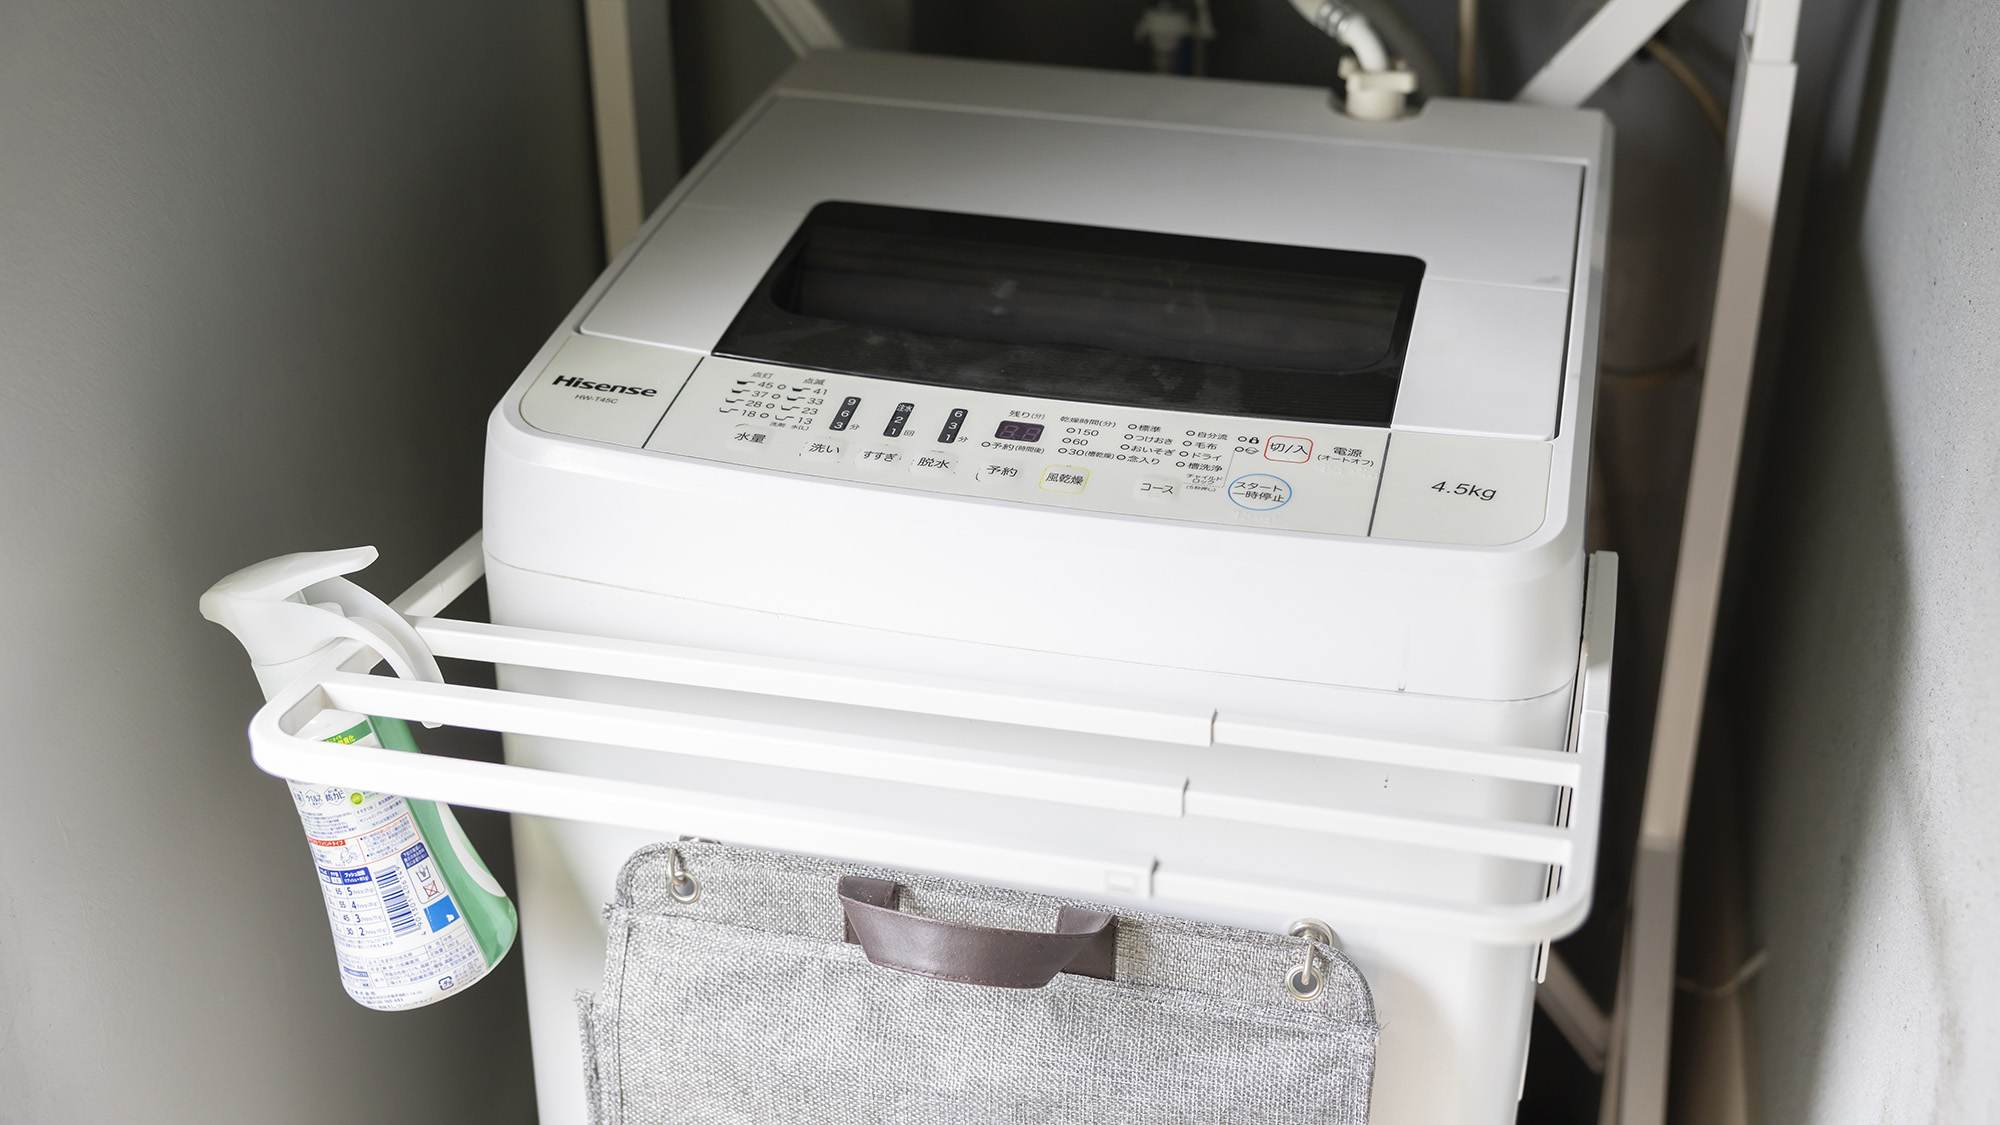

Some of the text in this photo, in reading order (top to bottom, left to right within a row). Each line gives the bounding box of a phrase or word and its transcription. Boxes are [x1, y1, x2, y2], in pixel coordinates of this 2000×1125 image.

[752, 371, 774, 379] 点灯
[552, 375, 658, 397] Hisense
[802, 378, 826, 386] 点滅
[756, 381, 828, 396] 45 41
[575, 394, 619, 405] HW-T45C
[751, 390, 824, 406] 37 33
[847, 398, 856, 406] 9
[745, 399, 819, 416] 28 23
[741, 409, 813, 425] 18 13
[841, 410, 850, 418] 6
[894, 415, 904, 424] 2
[954, 410, 964, 418] 6
[834, 422, 844, 430] 3
[948, 422, 958, 430] 3
[1138, 424, 1162, 433] 標準
[734, 431, 767, 444] 水量
[890, 428, 897, 436] 1
[1077, 427, 1099, 437] 150
[1197, 431, 1229, 441] 自分流
[945, 434, 952, 442] 1
[1072, 438, 1089, 446] 60
[1135, 434, 1174, 445] つけおき
[808, 443, 841, 454] 洗い
[1130, 445, 1176, 456] おいそぎ
[1194, 441, 1218, 450] 毛布
[1269, 441, 1309, 456] 切/入
[863, 450, 899, 462] すすぎ
[1191, 452, 1223, 462] ドライ
[1333, 446, 1364, 458] 電源
[917, 457, 950, 470] 脱水
[1127, 455, 1161, 466] 念入り
[1317, 454, 1375, 467] (オートオフ)
[986, 464, 1018, 477] 予約
[1187, 462, 1223, 472] 槽洗浄
[1045, 472, 1085, 486] 風乾燥
[1139, 482, 1175, 494] コース
[1234, 481, 1283, 493] スタート
[1431, 481, 1497, 502] 4.5kg
[1232, 491, 1285, 503] 一時停止
